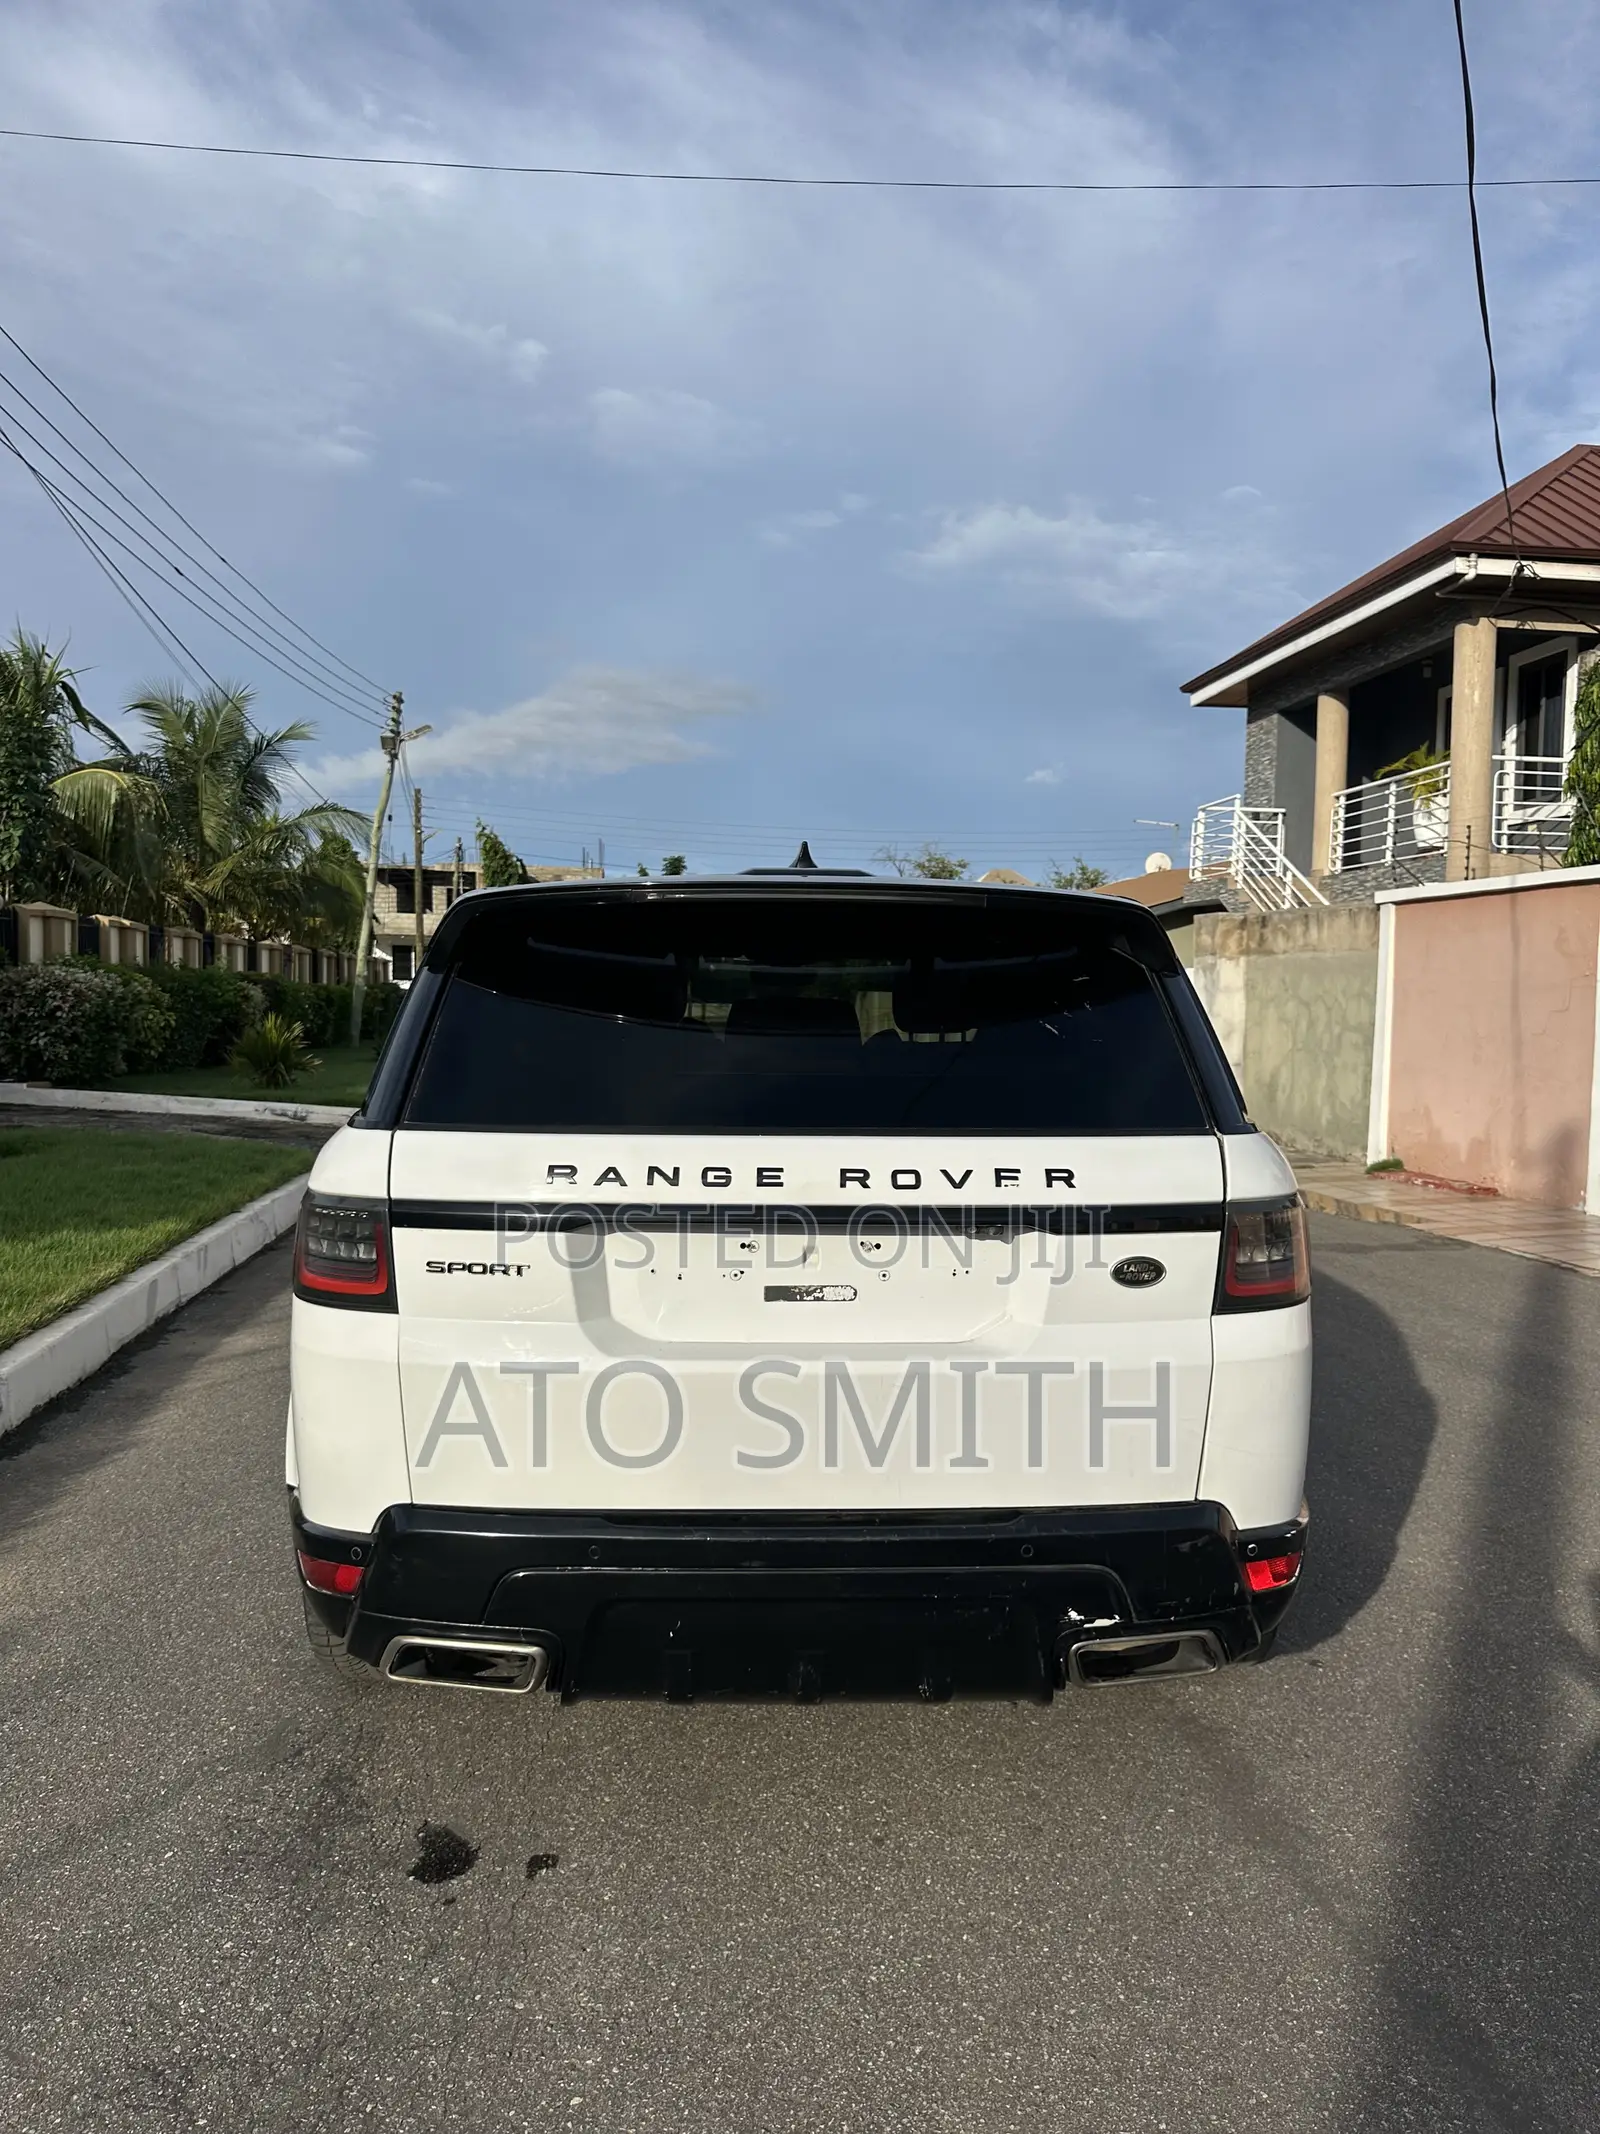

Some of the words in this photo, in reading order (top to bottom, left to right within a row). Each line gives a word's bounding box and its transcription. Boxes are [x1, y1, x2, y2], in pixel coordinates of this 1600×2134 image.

[546, 1164, 785, 1188] RANGE
[839, 1167, 1077, 1190] ROVER
[425, 1260, 531, 1277] SPORT
[1123, 1263, 1149, 1272] LAND
[1124, 1271, 1157, 1281] ROVER
